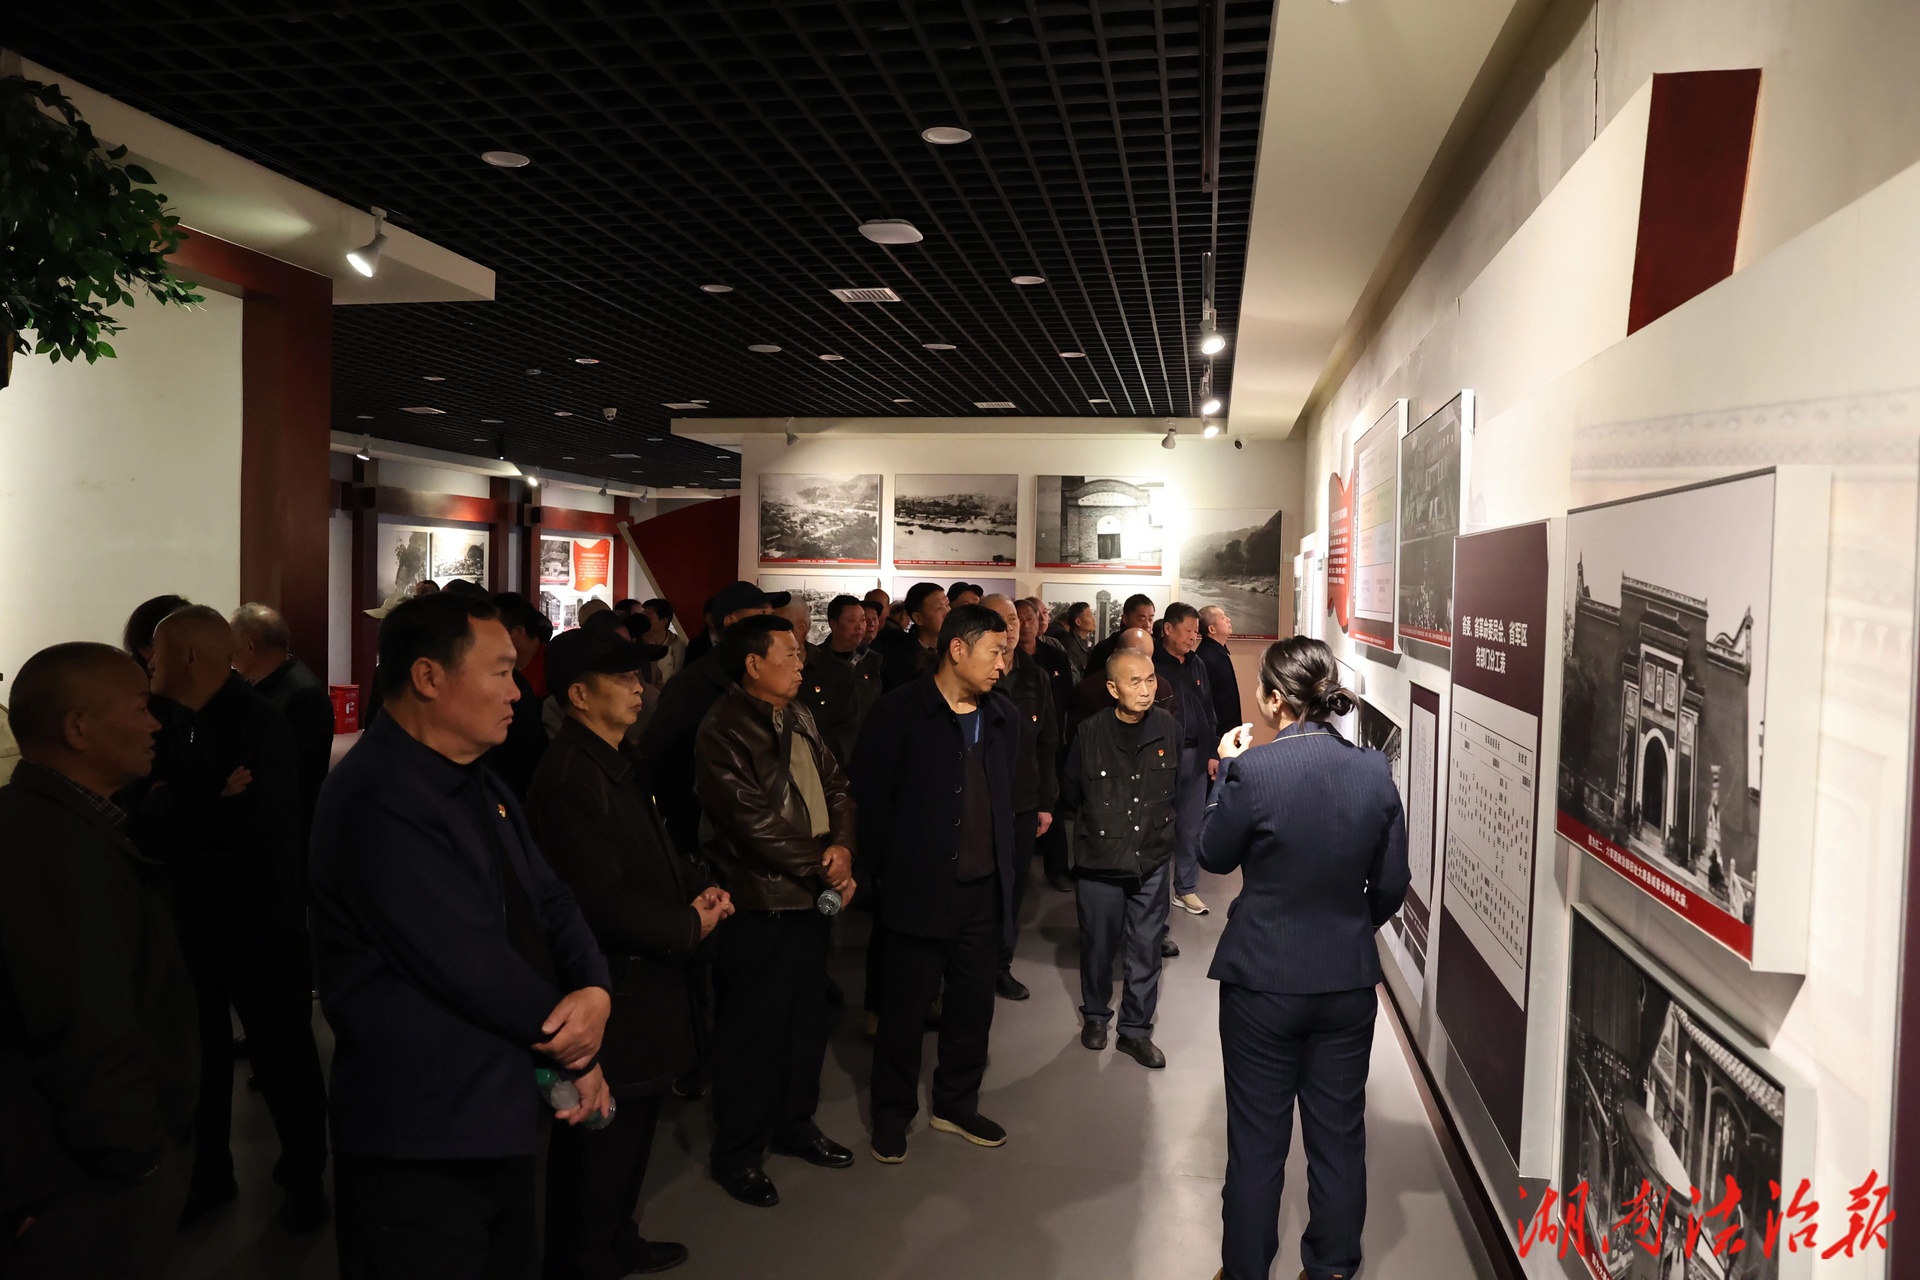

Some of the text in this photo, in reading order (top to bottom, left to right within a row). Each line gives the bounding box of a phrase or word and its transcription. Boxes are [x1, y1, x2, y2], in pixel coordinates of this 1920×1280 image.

[1462, 615, 1528, 648] 省委、省革命委员会、省军区
[1475, 645, 1506, 675] 各部门分工表
